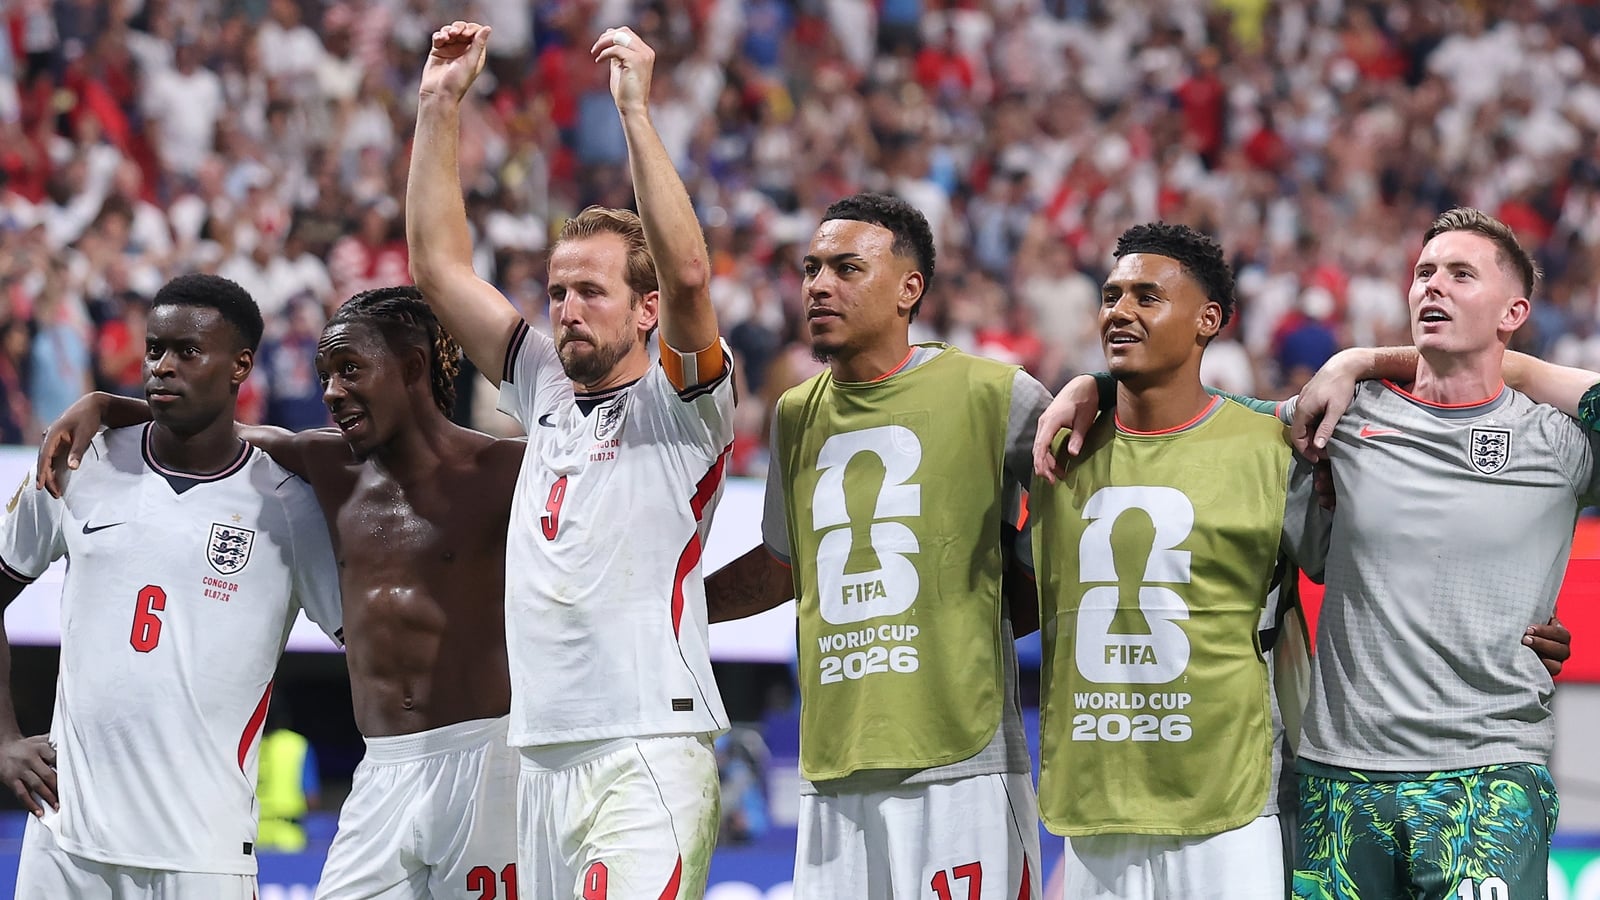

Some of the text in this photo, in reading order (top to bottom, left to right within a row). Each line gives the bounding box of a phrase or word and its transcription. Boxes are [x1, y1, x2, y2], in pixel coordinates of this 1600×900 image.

[540, 475, 568, 541] 9
[202, 576, 239, 592] CONGO DR
[204, 589, 230, 602] 01.07.26
[842, 580, 887, 605] FIFA
[130, 584, 167, 653] 6
[818, 624, 920, 653] WORLD CUP
[820, 646, 919, 685] 2026
[1104, 645, 1158, 665] FIFA
[1074, 692, 1191, 710] WORLD CUP
[1072, 713, 1192, 742] 2026
[466, 863, 518, 900] 21
[931, 861, 982, 900] 17
